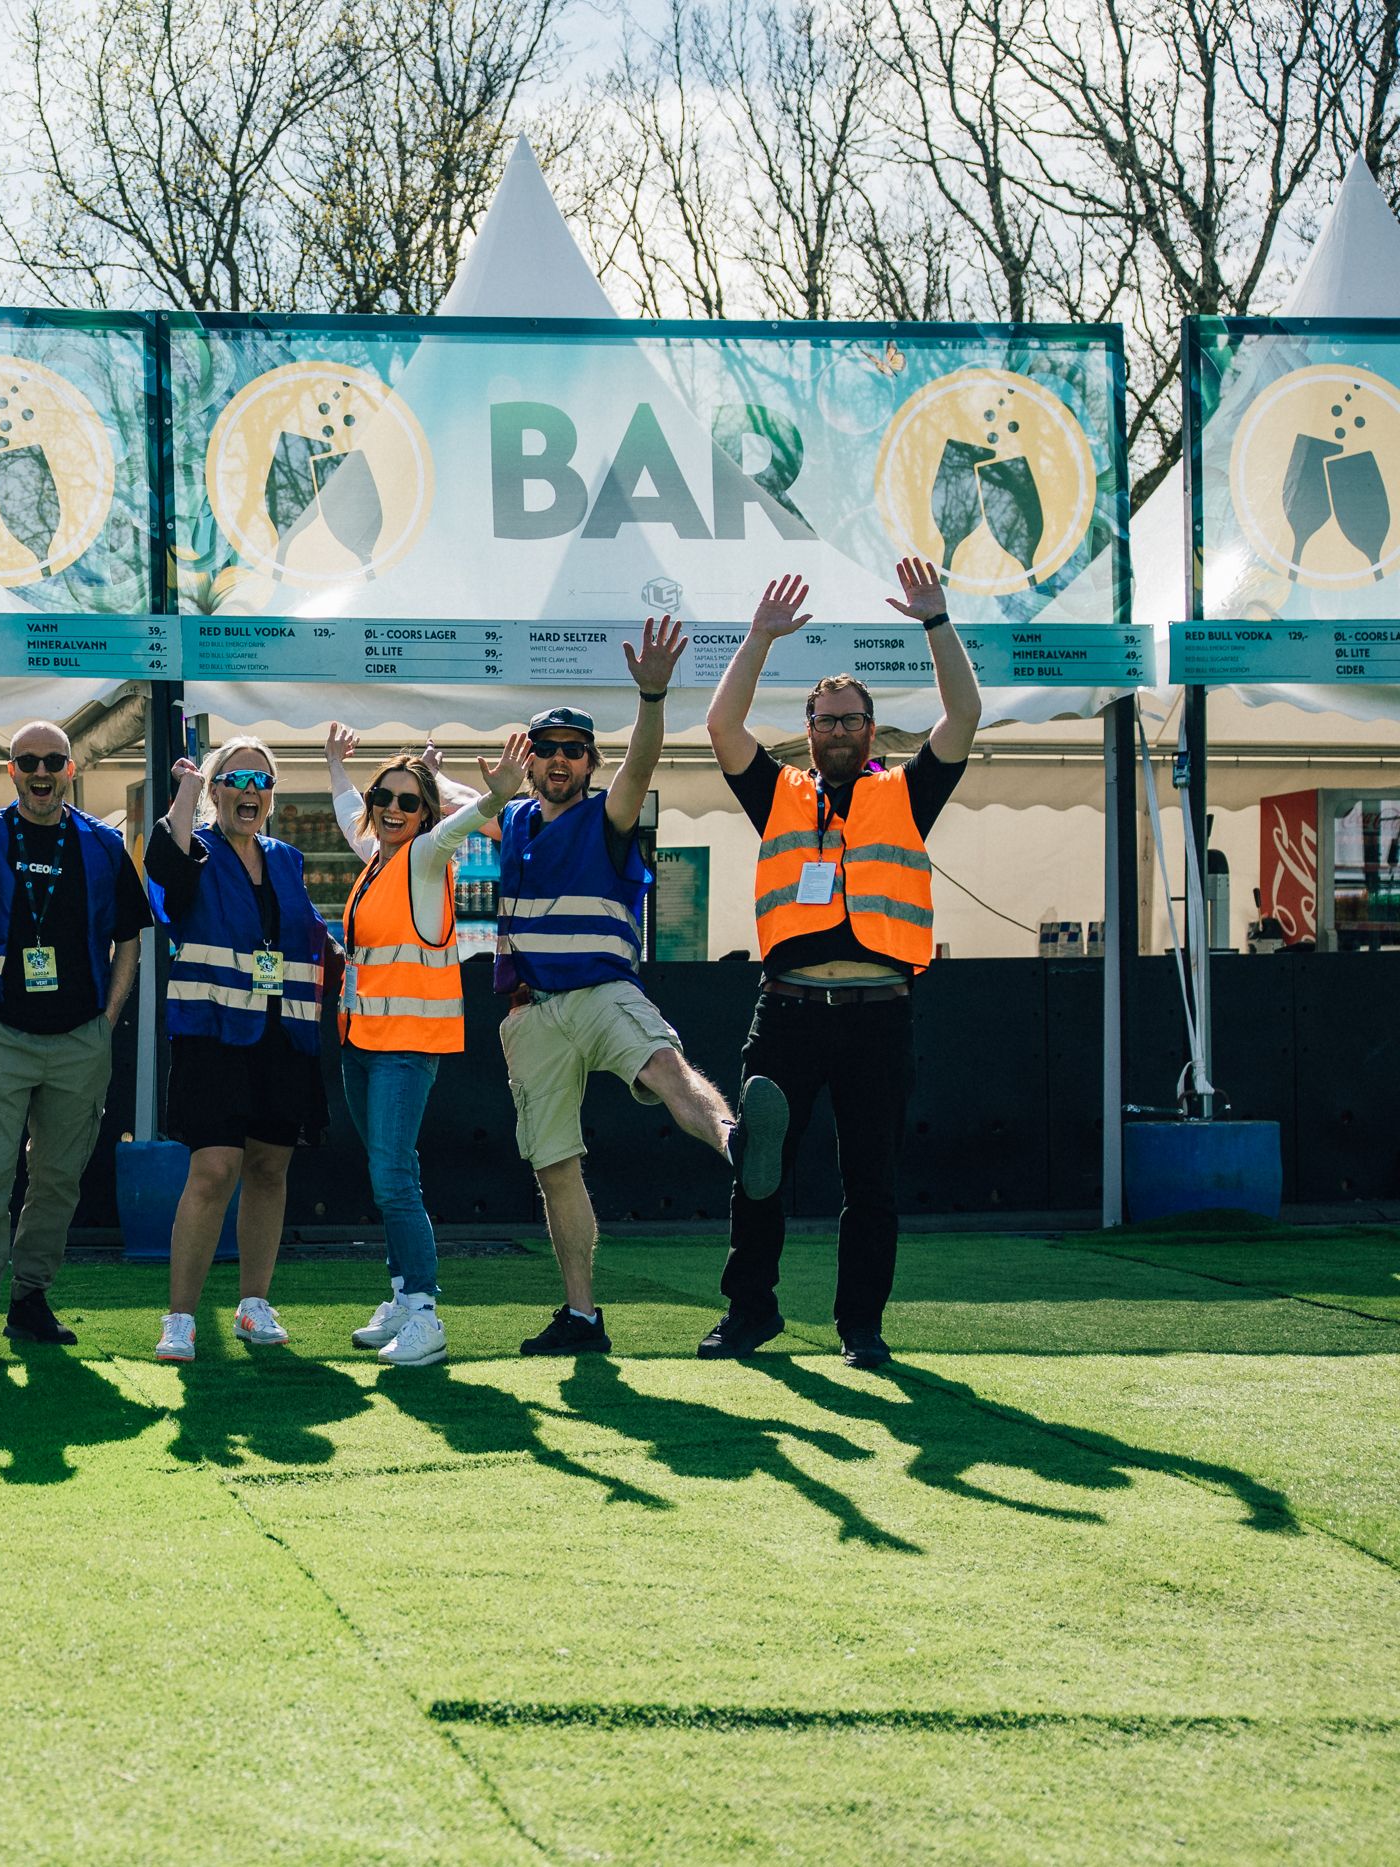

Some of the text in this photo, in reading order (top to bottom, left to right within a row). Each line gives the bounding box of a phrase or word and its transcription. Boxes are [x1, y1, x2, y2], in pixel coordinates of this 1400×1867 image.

[490, 401, 820, 541] BAR
[27, 624, 166, 637] VANN 39,-
[200, 627, 335, 638] RED BULL VODKA 129,-
[364, 629, 378, 639] ØL
[387, 630, 422, 639] COORS
[425, 631, 456, 640] LAGER
[485, 632, 503, 642] 99,-
[529, 633, 607, 642] HARD SELTZER
[806, 636, 826, 645] 129,-
[1013, 634, 1140, 645] VANN 39,-
[1185, 632, 1308, 641] RED BULL VODKA 129,-
[1334, 632, 1346, 642] ØL
[1355, 632, 1388, 640] COORS
[28, 640, 167, 653] MINERALVANN 49,-
[854, 639, 983, 650] SHOTSRØR 55,-
[365, 646, 502, 659] ØL LITE 99,-
[1013, 651, 1142, 661] MINERALVANN 49,-
[1335, 648, 1370, 658] ØL LITE
[28, 657, 167, 669] RED BULL 49,-
[855, 661, 905, 672] SHOTSRØR
[908, 663, 918, 671] 10
[365, 664, 503, 675] CIDER 99,-
[1014, 667, 1143, 678] RED BULL 49,-
[1336, 666, 1365, 675] CIDER
[657, 851, 681, 863] ENY
